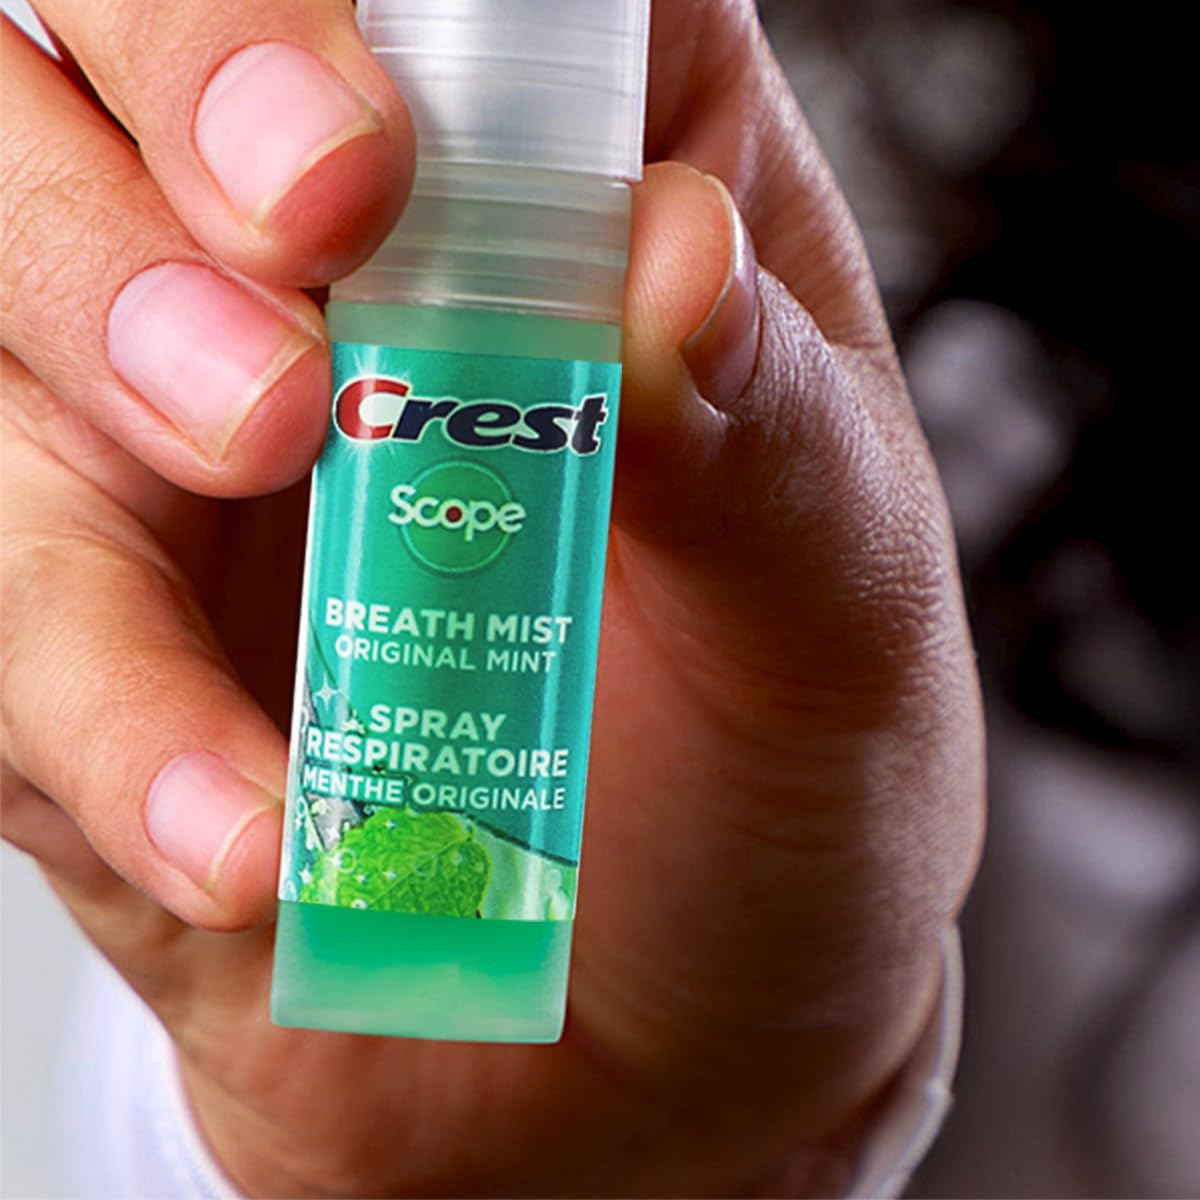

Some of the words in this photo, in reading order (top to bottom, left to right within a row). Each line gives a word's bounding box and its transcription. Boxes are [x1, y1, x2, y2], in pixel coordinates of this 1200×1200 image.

[333, 375, 608, 456] Crest
[388, 485, 526, 541] Scope
[325, 598, 475, 641] BREATH
[486, 614, 573, 645] MIST
[334, 635, 476, 671] ORIGINAL
[486, 649, 557, 673] MINT
[369, 704, 507, 741] SPRAY
[305, 726, 569, 778] RESPIRATOIRE
[302, 764, 403, 803] MENTHE
[411, 782, 566, 811] ORIGINALE
